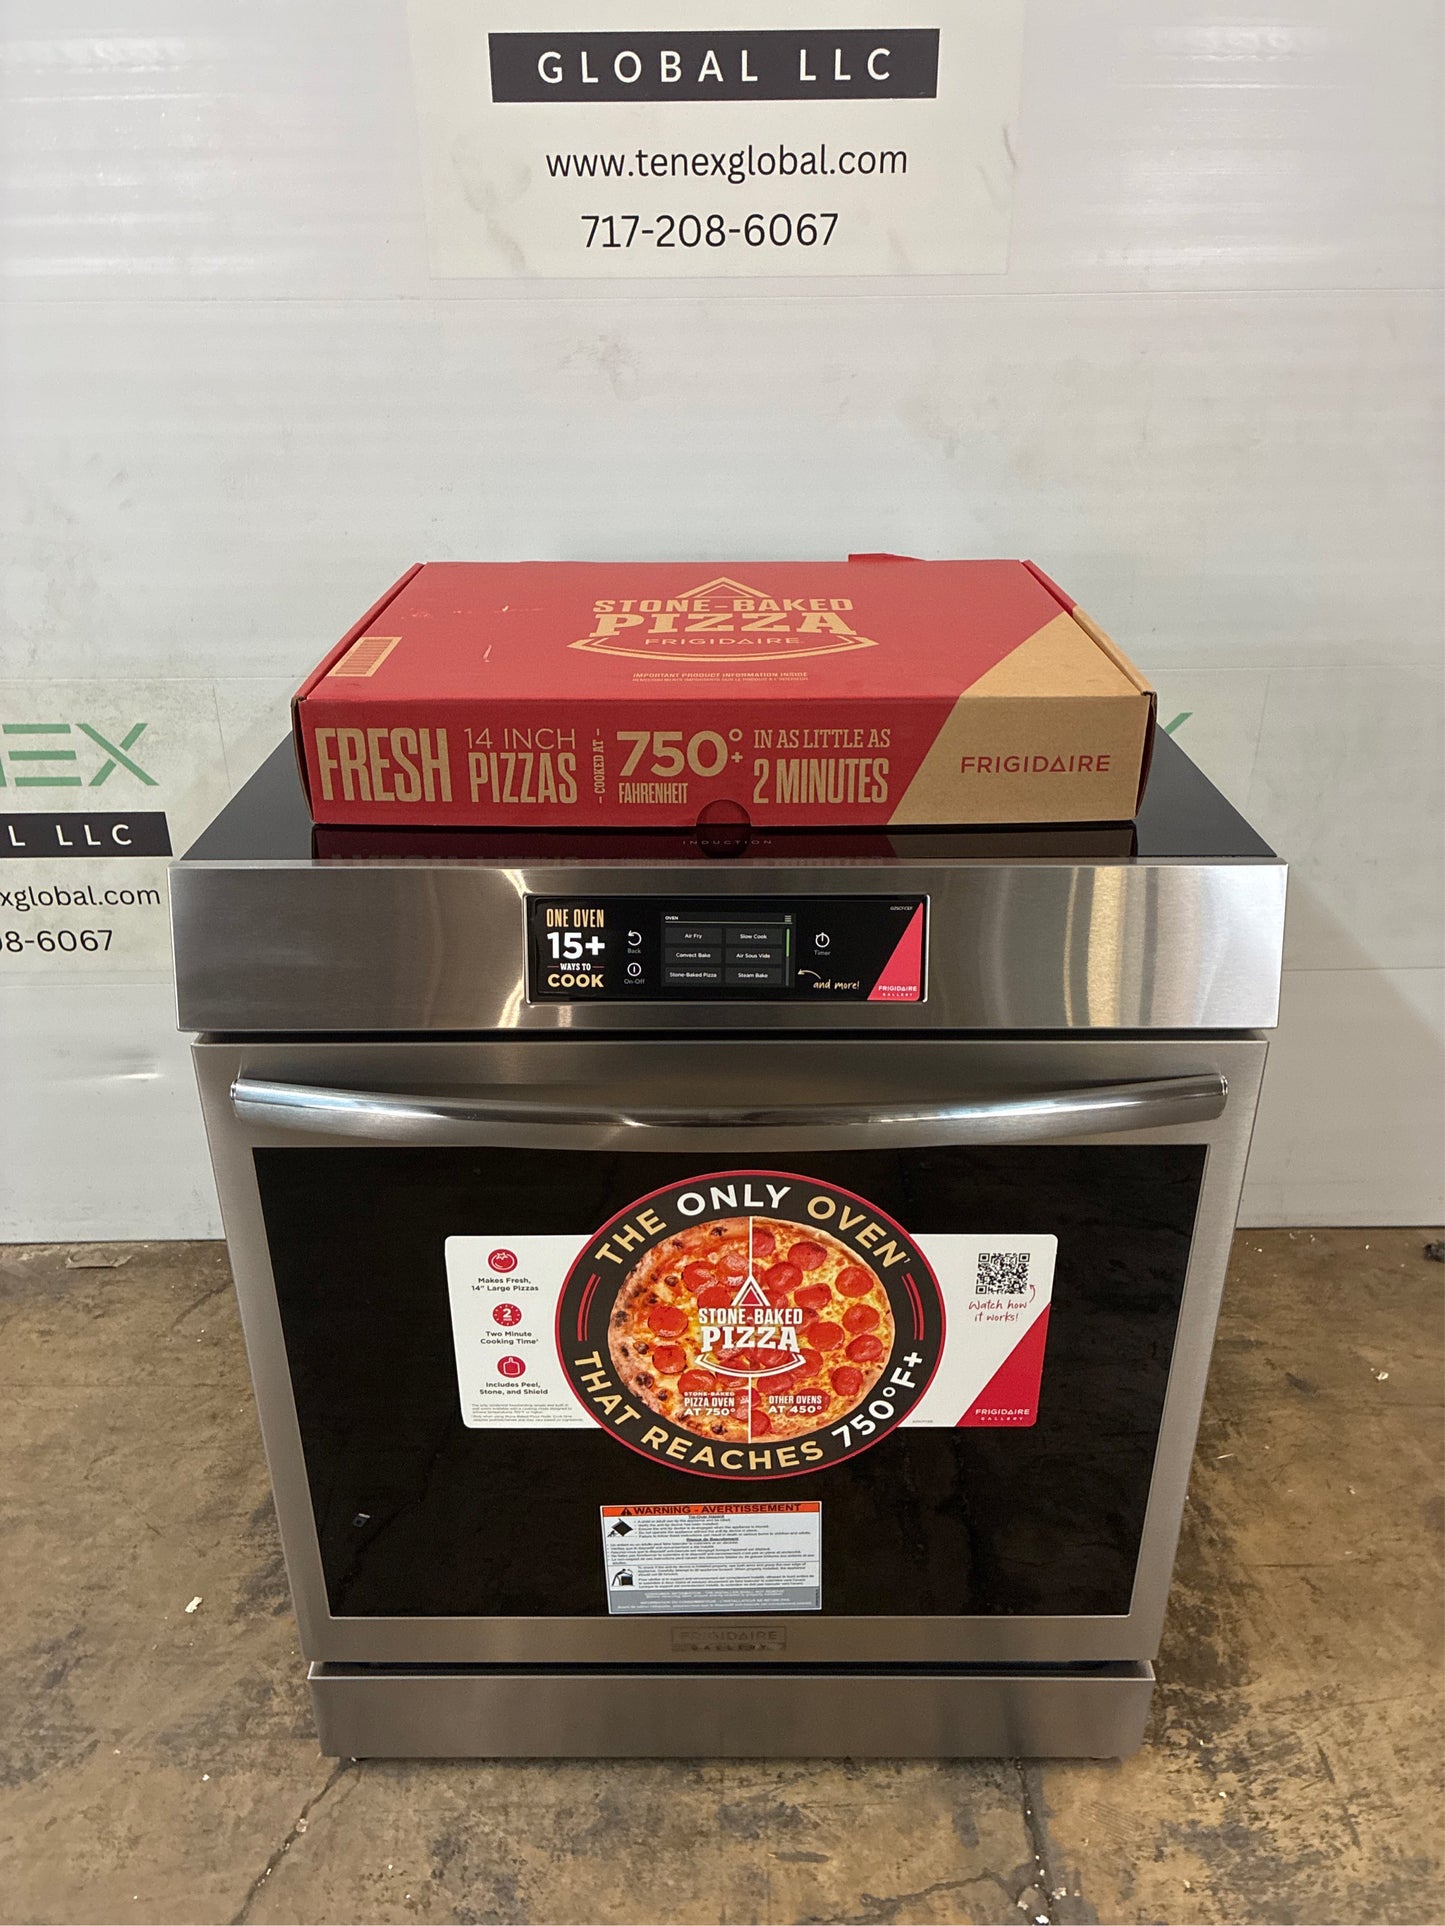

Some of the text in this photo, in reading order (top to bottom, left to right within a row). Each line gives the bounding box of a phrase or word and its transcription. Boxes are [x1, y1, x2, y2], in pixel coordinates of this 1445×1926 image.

[537, 47, 891, 83] GLOBAL LLC
[546, 144, 908, 184] www.tenexglobal.com
[580, 212, 840, 249] 717-208-6067
[593, 598, 853, 613] STONE-BAKED
[589, 612, 857, 637] PIZZA
[644, 637, 801, 645] FRIGIDAIRE
[464, 728, 576, 749] 14 INCH
[754, 729, 891, 749] IN AS LITTLE AS
[315, 727, 453, 803] FRESH
[592, 739, 605, 794] COOKED AT
[961, 755, 1111, 774] FRIGIDAIRE
[468, 752, 577, 804] PIZZAS
[753, 757, 889, 804] 2 MINUTES
[619, 783, 688, 804] FAHRENHEIT
[55, 823, 132, 846] LLC
[546, 908, 605, 928] ONE OVEN
[0, 930, 114, 952] 8-6067
[547, 931, 606, 960] 15+
[560, 962, 592, 971] WAYS TO
[547, 973, 604, 988] COOK
[623, 977, 645, 985] On-Off
[812, 979, 860, 990] and more!
[595, 1208, 667, 1265] THE
[677, 1184, 791, 1217] ONLY
[502, 1308, 512, 1318] 2
[968, 1300, 1028, 1310] Watch how
[698, 1308, 803, 1325] STONE-BAKED
[974, 1312, 1019, 1322] it works!
[700, 1326, 800, 1353] PIZZA
[684, 1397, 735, 1407] PIZZA OVEN
[768, 1395, 822, 1404] OTHER OVENS
[768, 1405, 822, 1413] AT 450°
[574, 1351, 641, 1425] THAT
[641, 1425, 824, 1471] REACHES
[684, 1407, 736, 1416] AT 750°
[634, 1505, 691, 1515] WARNING
[702, 1503, 801, 1513] AVERTISSEMENT
